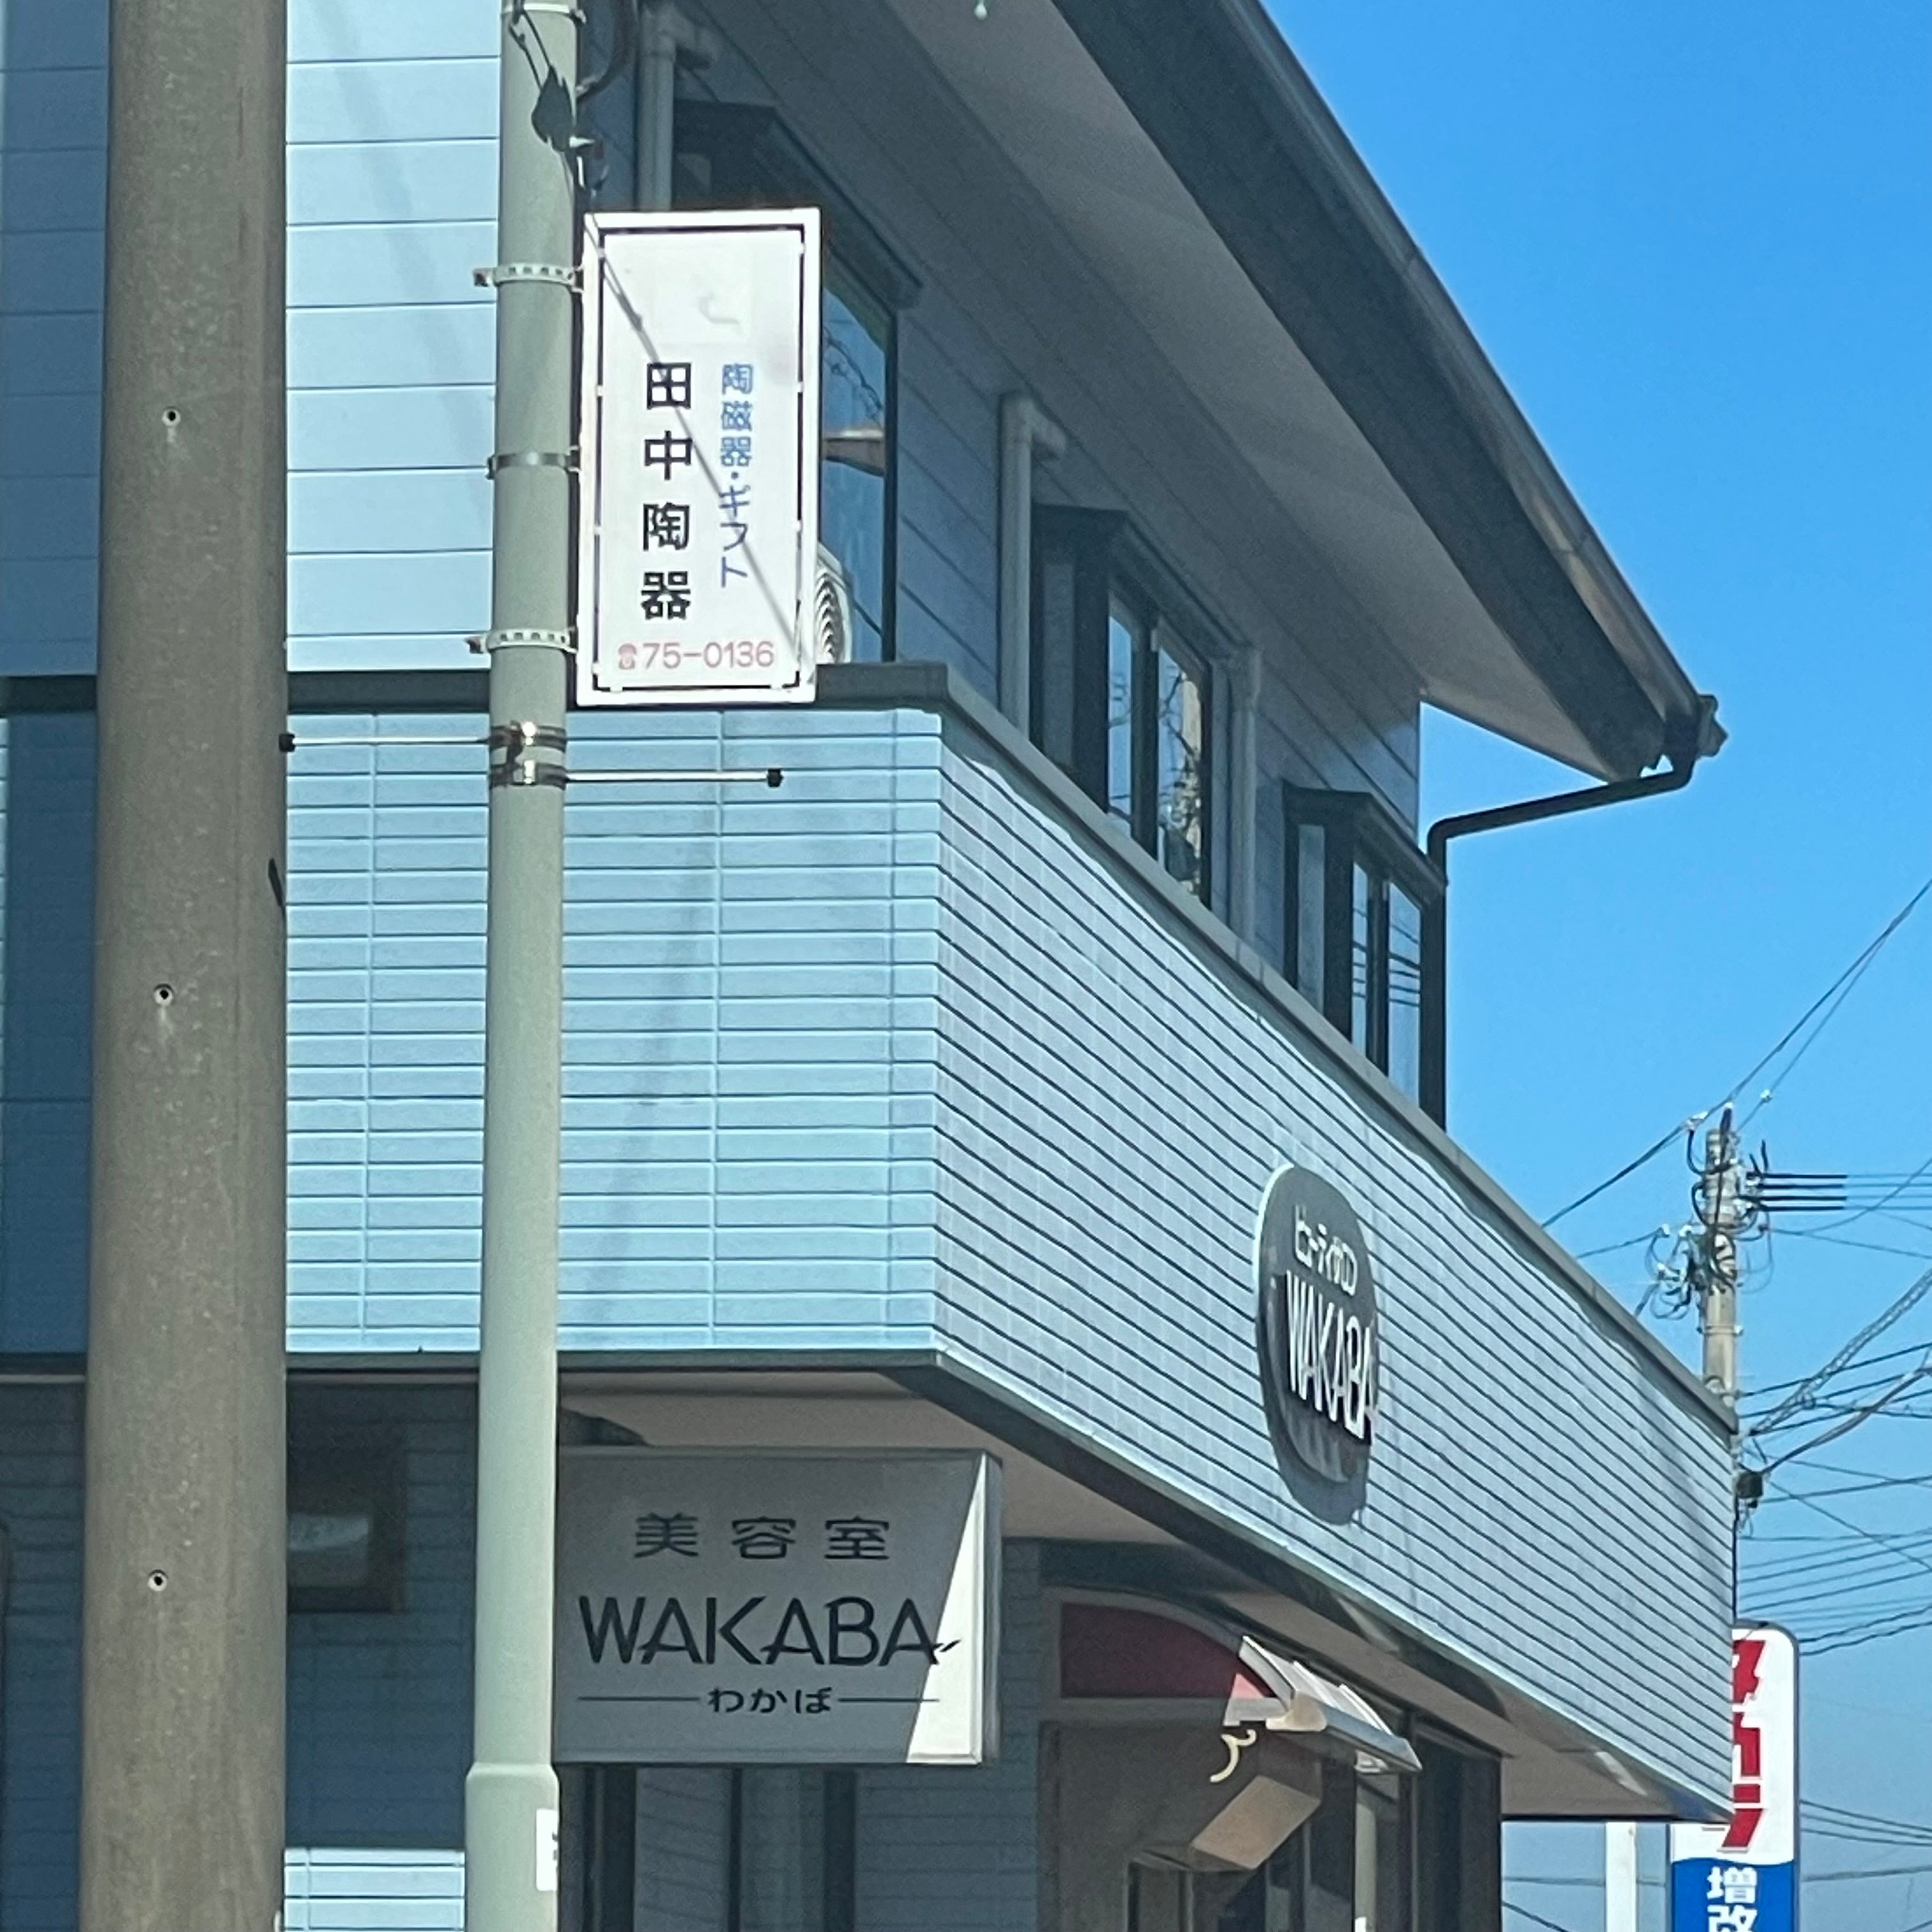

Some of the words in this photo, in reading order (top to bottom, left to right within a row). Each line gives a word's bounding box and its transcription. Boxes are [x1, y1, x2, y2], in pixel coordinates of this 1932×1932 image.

[640, 362, 693, 620] 田中陶器
[642, 640, 775, 670] 75-0136
[1285, 1269, 1376, 1441] WAKABA
[634, 1512, 891, 1561] 美容室
[579, 1595, 960, 1667] WAKABA
[707, 1687, 833, 1715] わかば
